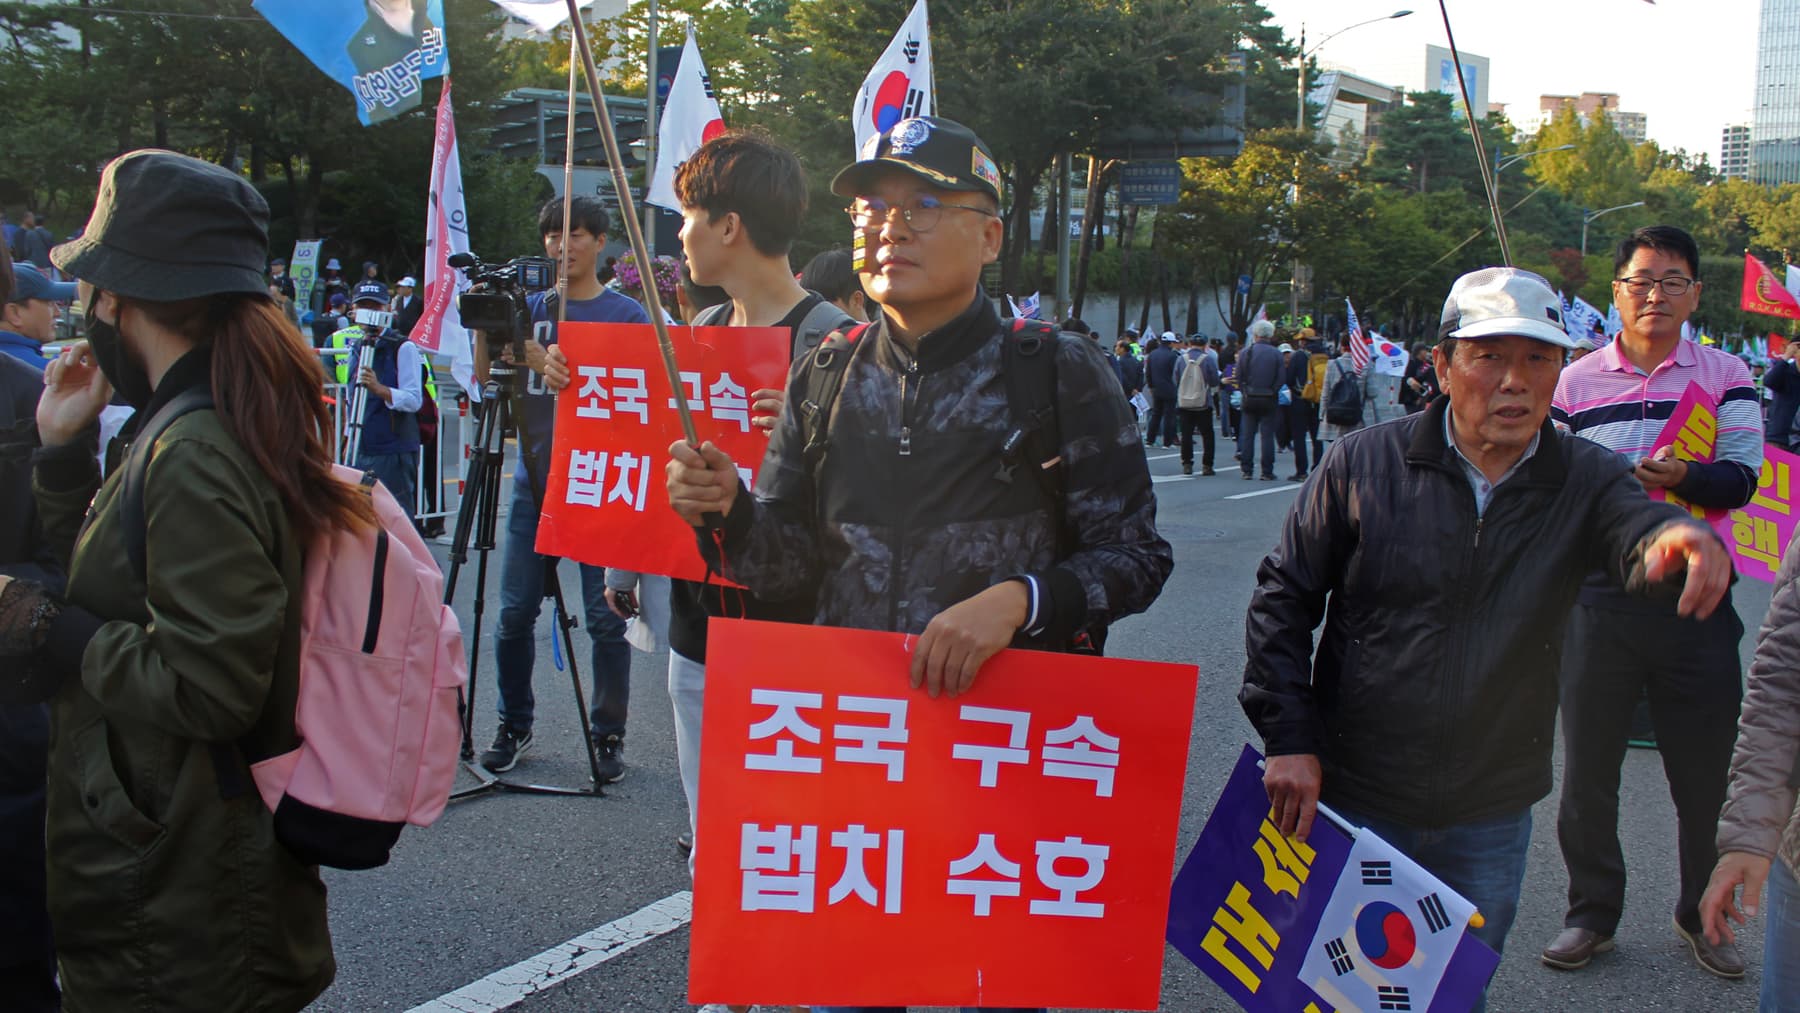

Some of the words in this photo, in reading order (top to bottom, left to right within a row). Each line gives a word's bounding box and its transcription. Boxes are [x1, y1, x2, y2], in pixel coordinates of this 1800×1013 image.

[576, 365, 648, 424] 조국
[565, 449, 650, 512] 법치
[744, 688, 909, 782] 조국
[952, 705, 1120, 798] 구속
[740, 823, 905, 914] 법치
[946, 833, 1110, 918] 수호
